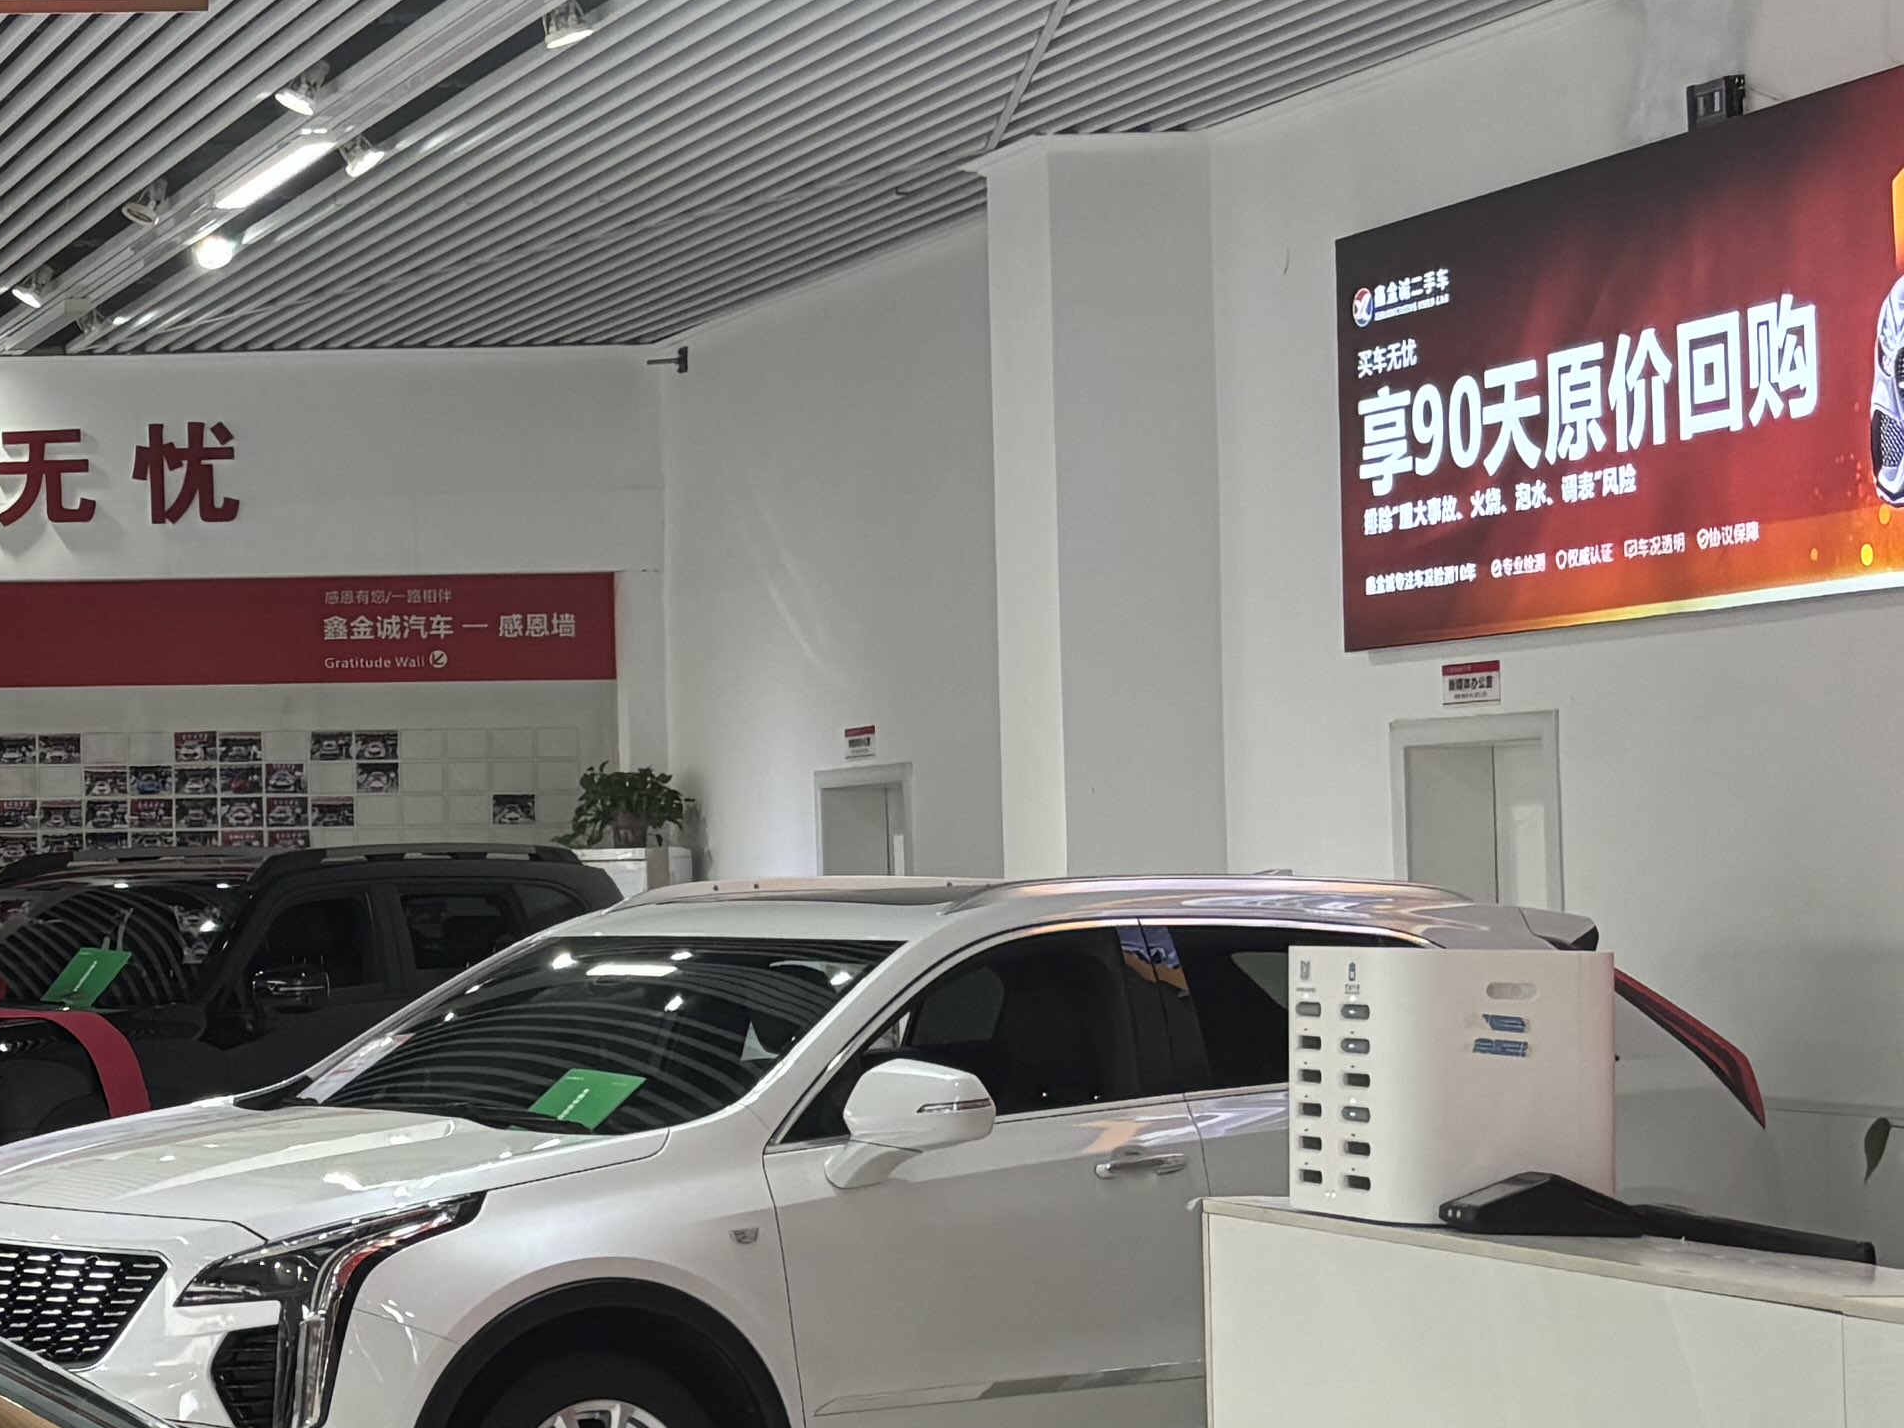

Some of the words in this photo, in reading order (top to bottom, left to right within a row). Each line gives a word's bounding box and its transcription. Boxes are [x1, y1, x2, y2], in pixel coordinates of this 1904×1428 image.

[1357, 338, 1418, 378] 买车无忧
[1357, 293, 1819, 497] 享90天原价回购
[1637, 532, 1685, 558] 车况透明
[323, 615, 454, 641] 鑫金诚汽车
[498, 614, 577, 638] 感恩墙
[324, 656, 391, 669] Gratitude
[395, 655, 425, 668] Wall
